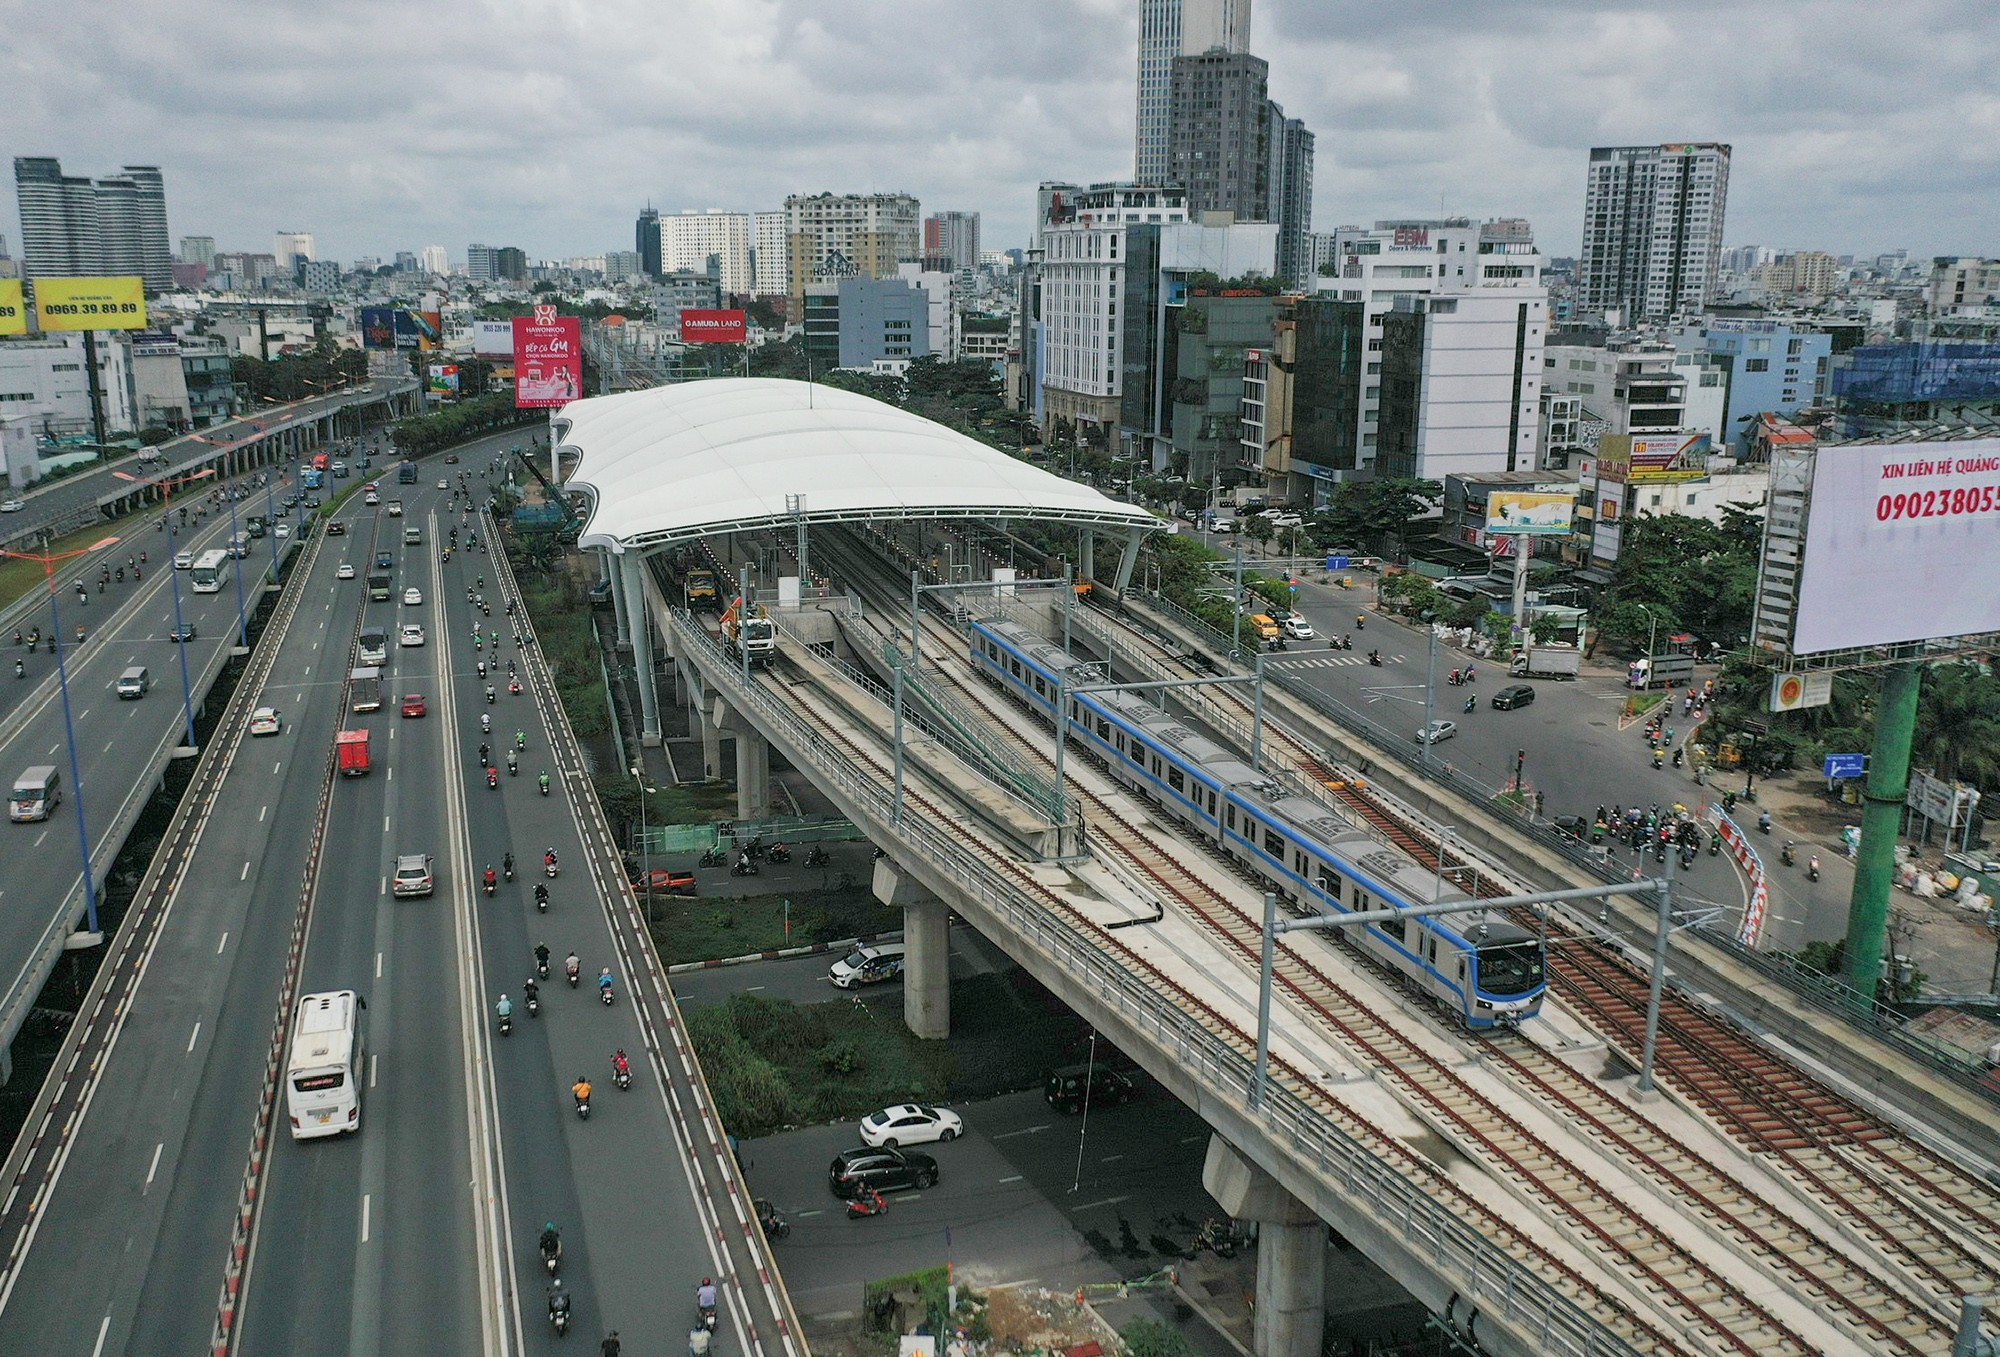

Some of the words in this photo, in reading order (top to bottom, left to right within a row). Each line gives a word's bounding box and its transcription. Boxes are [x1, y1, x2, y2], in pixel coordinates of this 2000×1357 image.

[1394, 228, 1428, 246] EBM
[45, 303, 137, 315] 0969.39.89.89
[685, 320, 720, 328] GAMUDA
[721, 320, 741, 328] LAND
[1881, 463, 1905, 479] XIN
[1907, 459, 1934, 477] LIÊN
[1936, 457, 1952, 477] HỆ
[1956, 453, 2000, 475] QUẢNG
